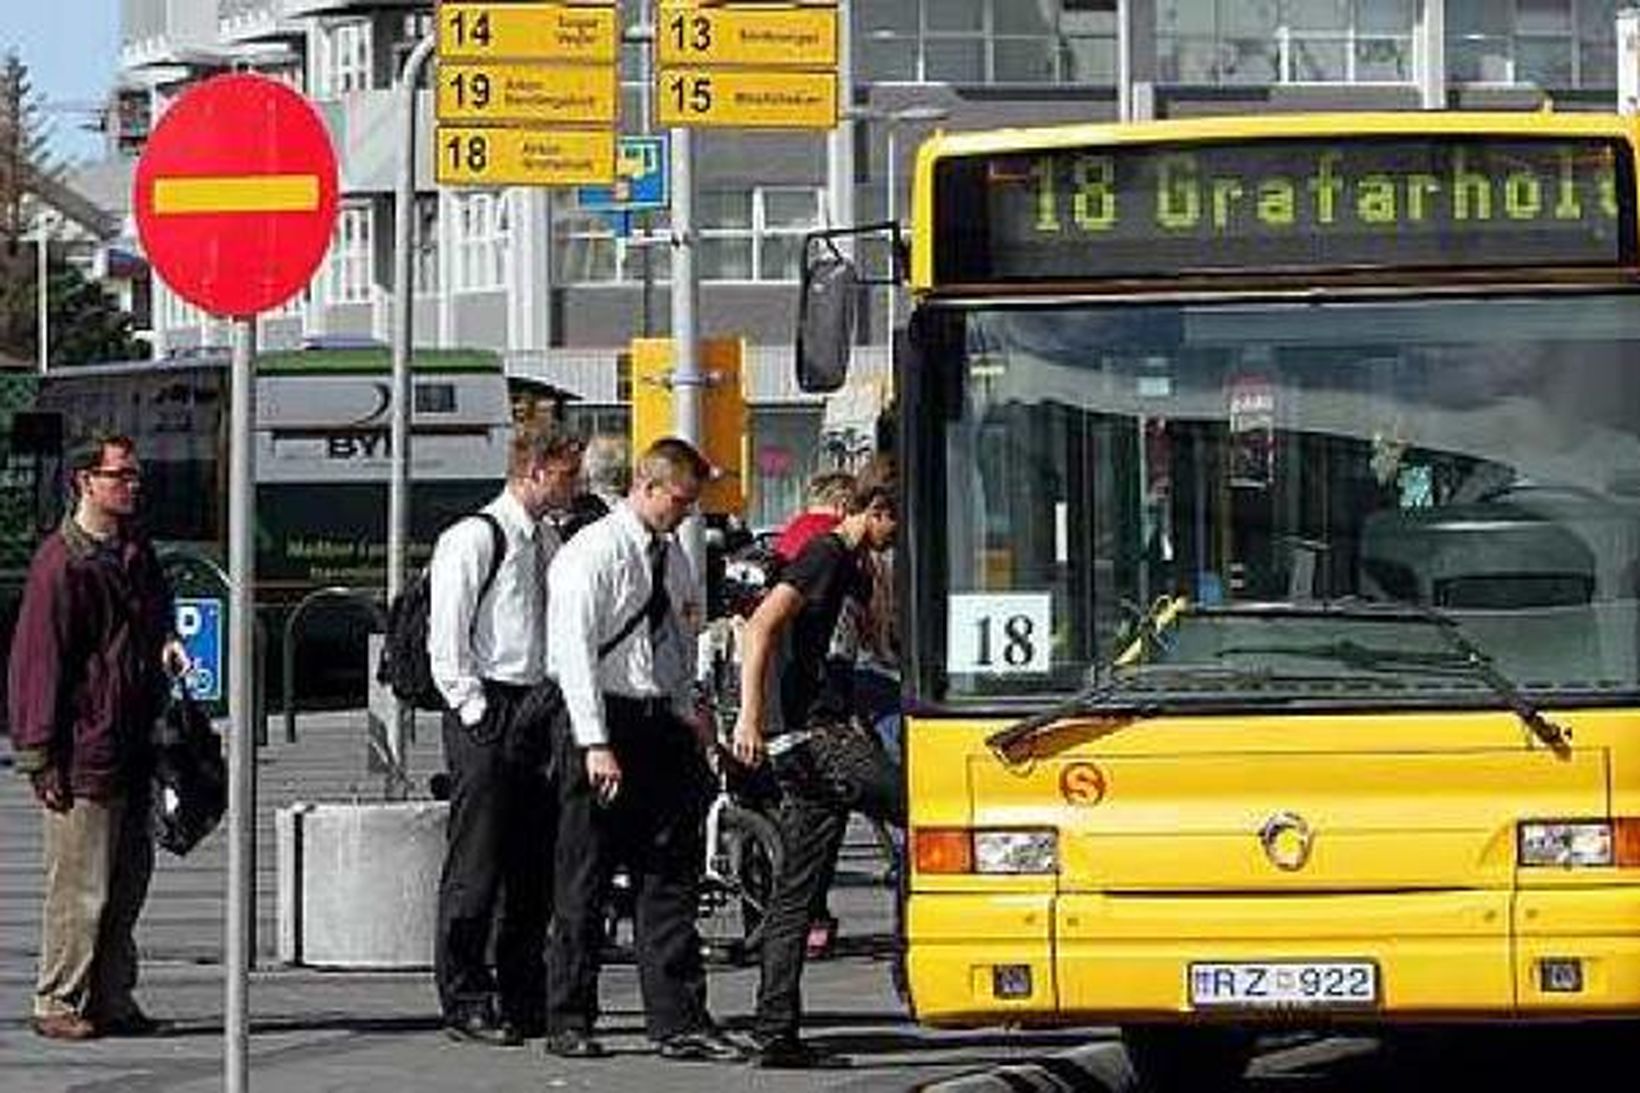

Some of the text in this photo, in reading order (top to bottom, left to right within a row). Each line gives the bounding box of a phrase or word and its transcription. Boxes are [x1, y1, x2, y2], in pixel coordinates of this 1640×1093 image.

[449, 11, 491, 47] 14
[671, 15, 711, 51] 13
[449, 73, 490, 109] 19
[671, 77, 711, 113] 15
[447, 136, 487, 172] 18
[1036, 155, 1115, 231] 18
[975, 614, 1034, 666] 18
[1299, 967, 1370, 997] 922
